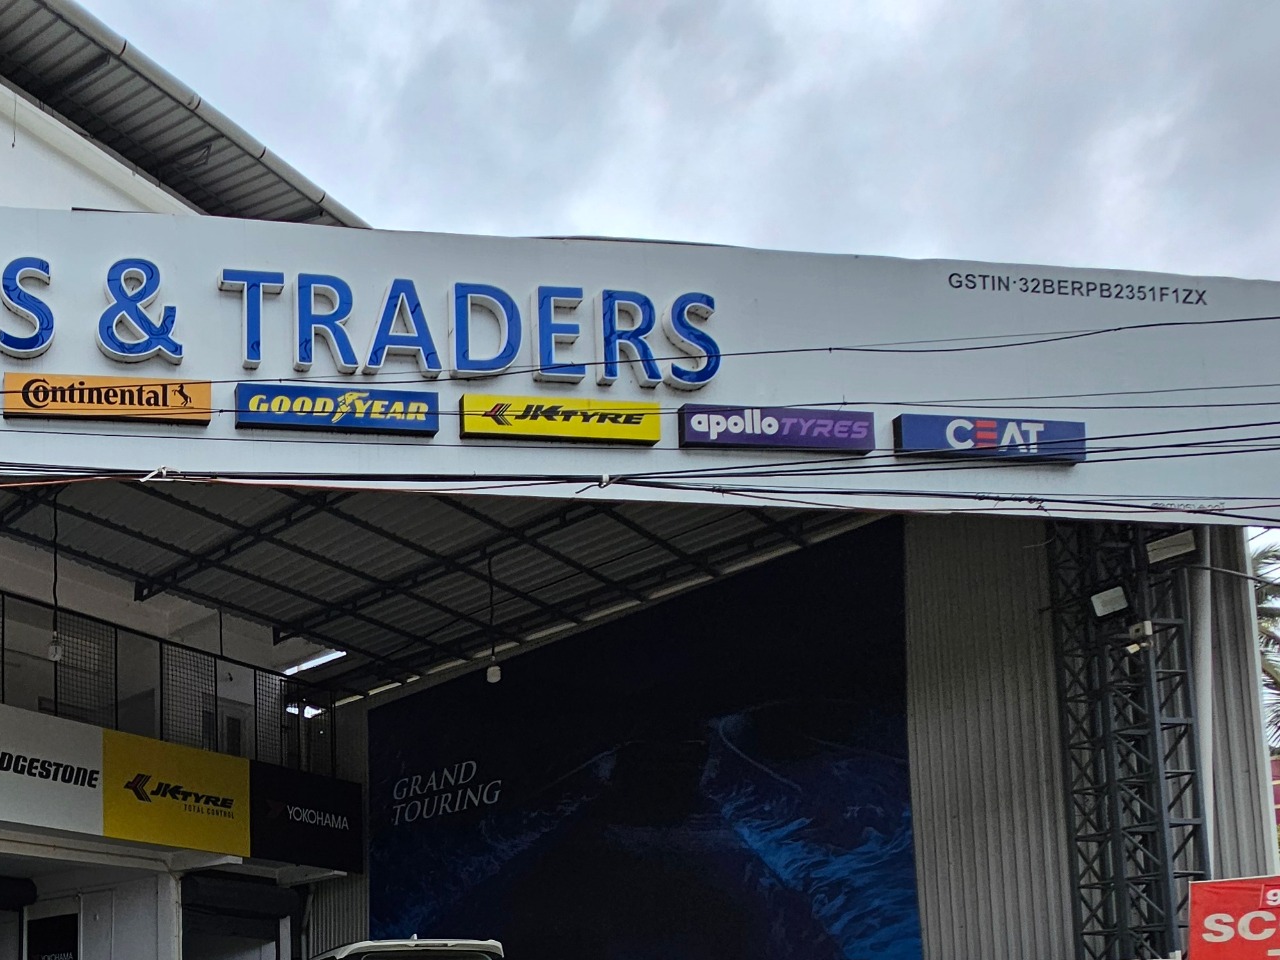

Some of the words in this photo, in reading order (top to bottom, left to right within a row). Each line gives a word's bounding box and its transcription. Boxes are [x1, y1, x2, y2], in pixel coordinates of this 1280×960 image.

[96, 257, 184, 364] &
[217, 268, 721, 391] TRADERS
[21, 376, 171, 408] Continental
[690, 409, 780, 440] apollo
[780, 417, 870, 440] TYRES
[946, 418, 1045, 454] CEAT
[393, 760, 477, 800] GRAND
[183, 803, 204, 816] TOTAL
[206, 808, 235, 820] CONTROL
[286, 805, 350, 831] YOKOHAMA
[392, 780, 502, 826] TOURING
[1201, 910, 1280, 943] SC
